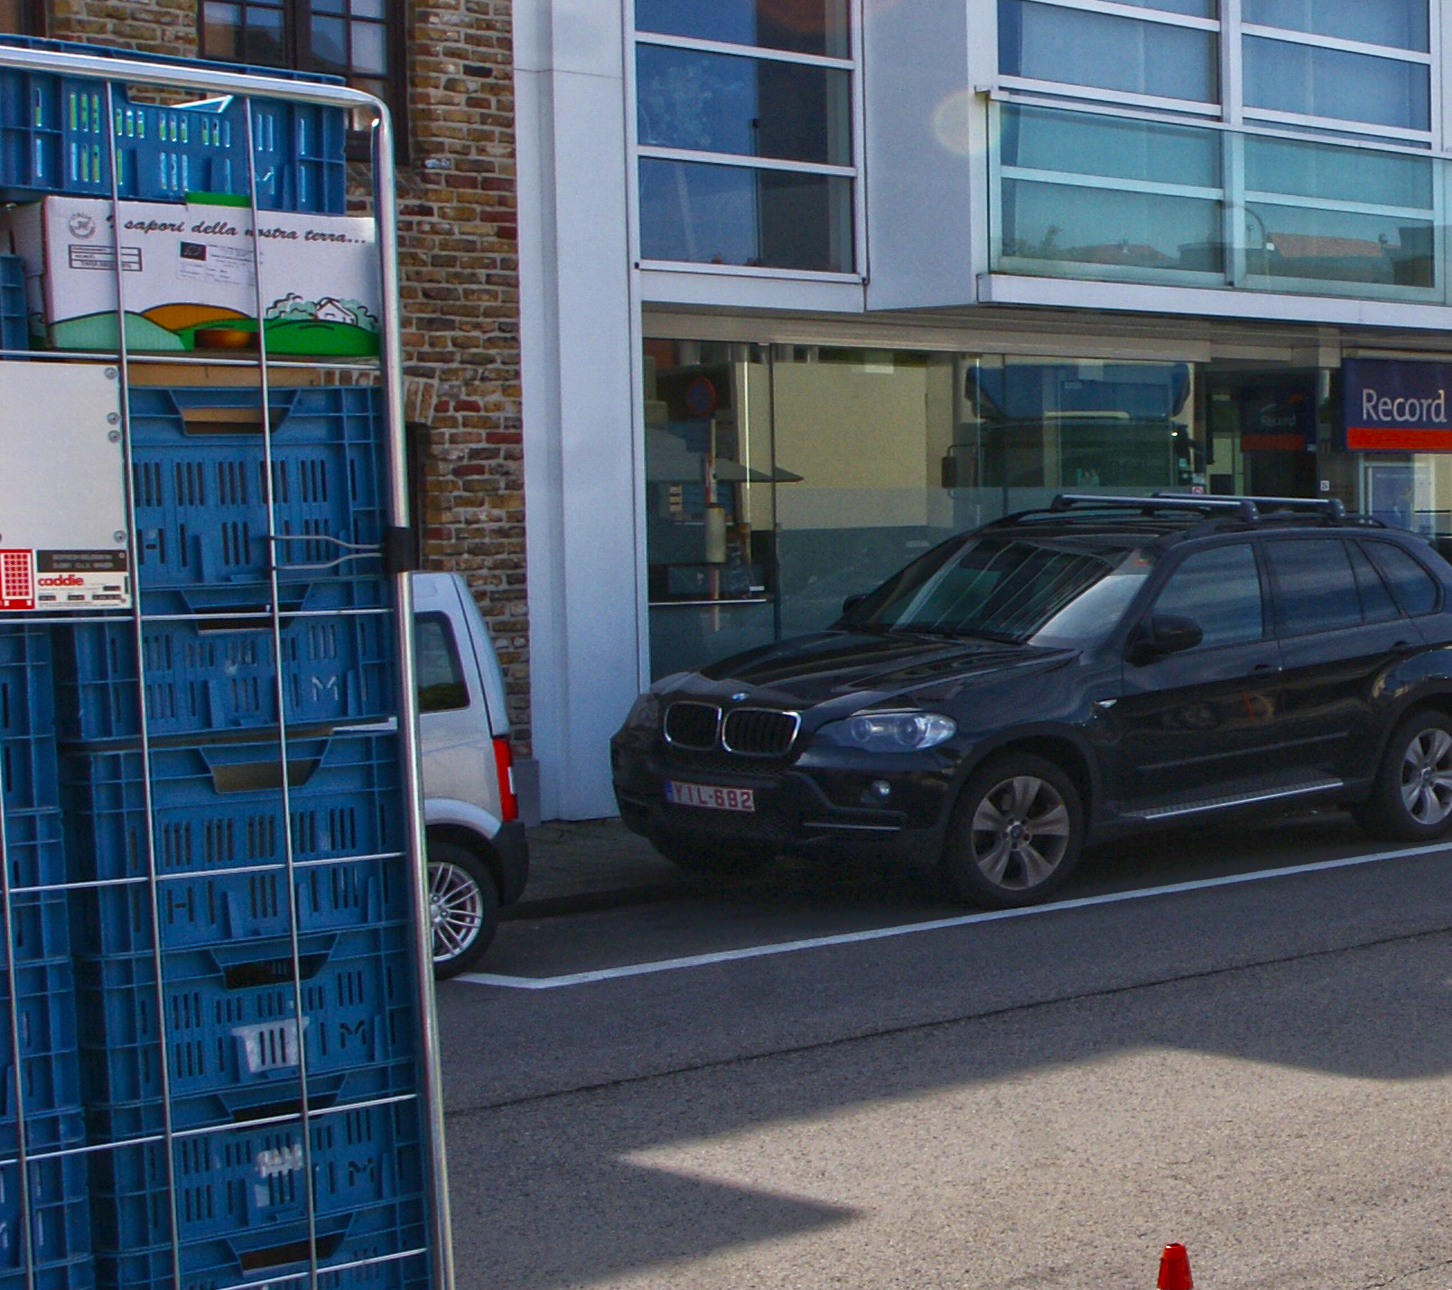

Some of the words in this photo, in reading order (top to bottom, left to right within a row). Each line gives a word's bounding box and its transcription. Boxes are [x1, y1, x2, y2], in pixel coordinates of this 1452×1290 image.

[124, 220, 185, 235] sapori
[191, 220, 238, 236] della
[1362, 388, 1448, 424] Record
[37, 573, 84, 587] caddie
